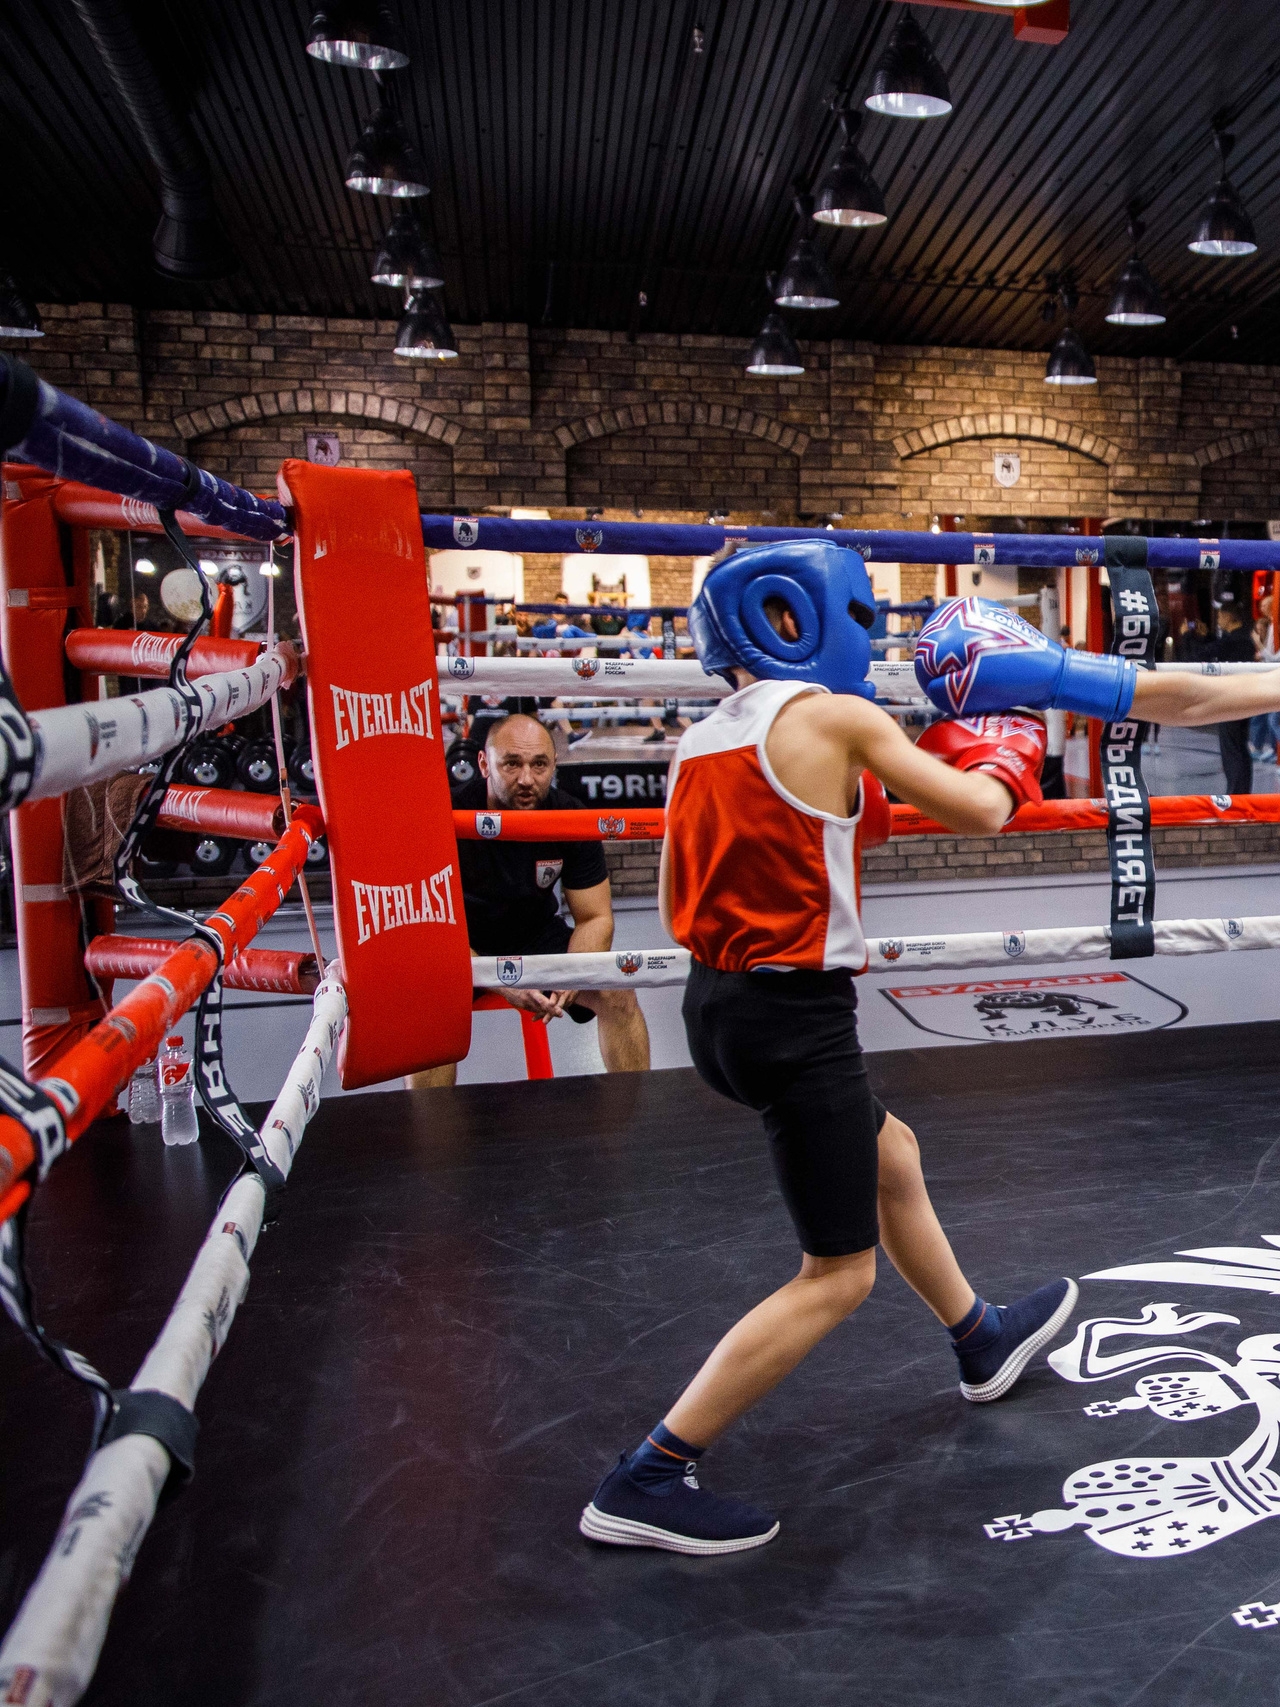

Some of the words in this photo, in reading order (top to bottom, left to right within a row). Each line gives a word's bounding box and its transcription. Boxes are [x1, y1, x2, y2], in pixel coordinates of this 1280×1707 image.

[329, 678, 434, 750] EVERLAST
[351, 864, 457, 946] EVERLAST
[899, 974, 1114, 997] БУЛЬДОГ
[983, 1013, 1142, 1032] КЛУБ
